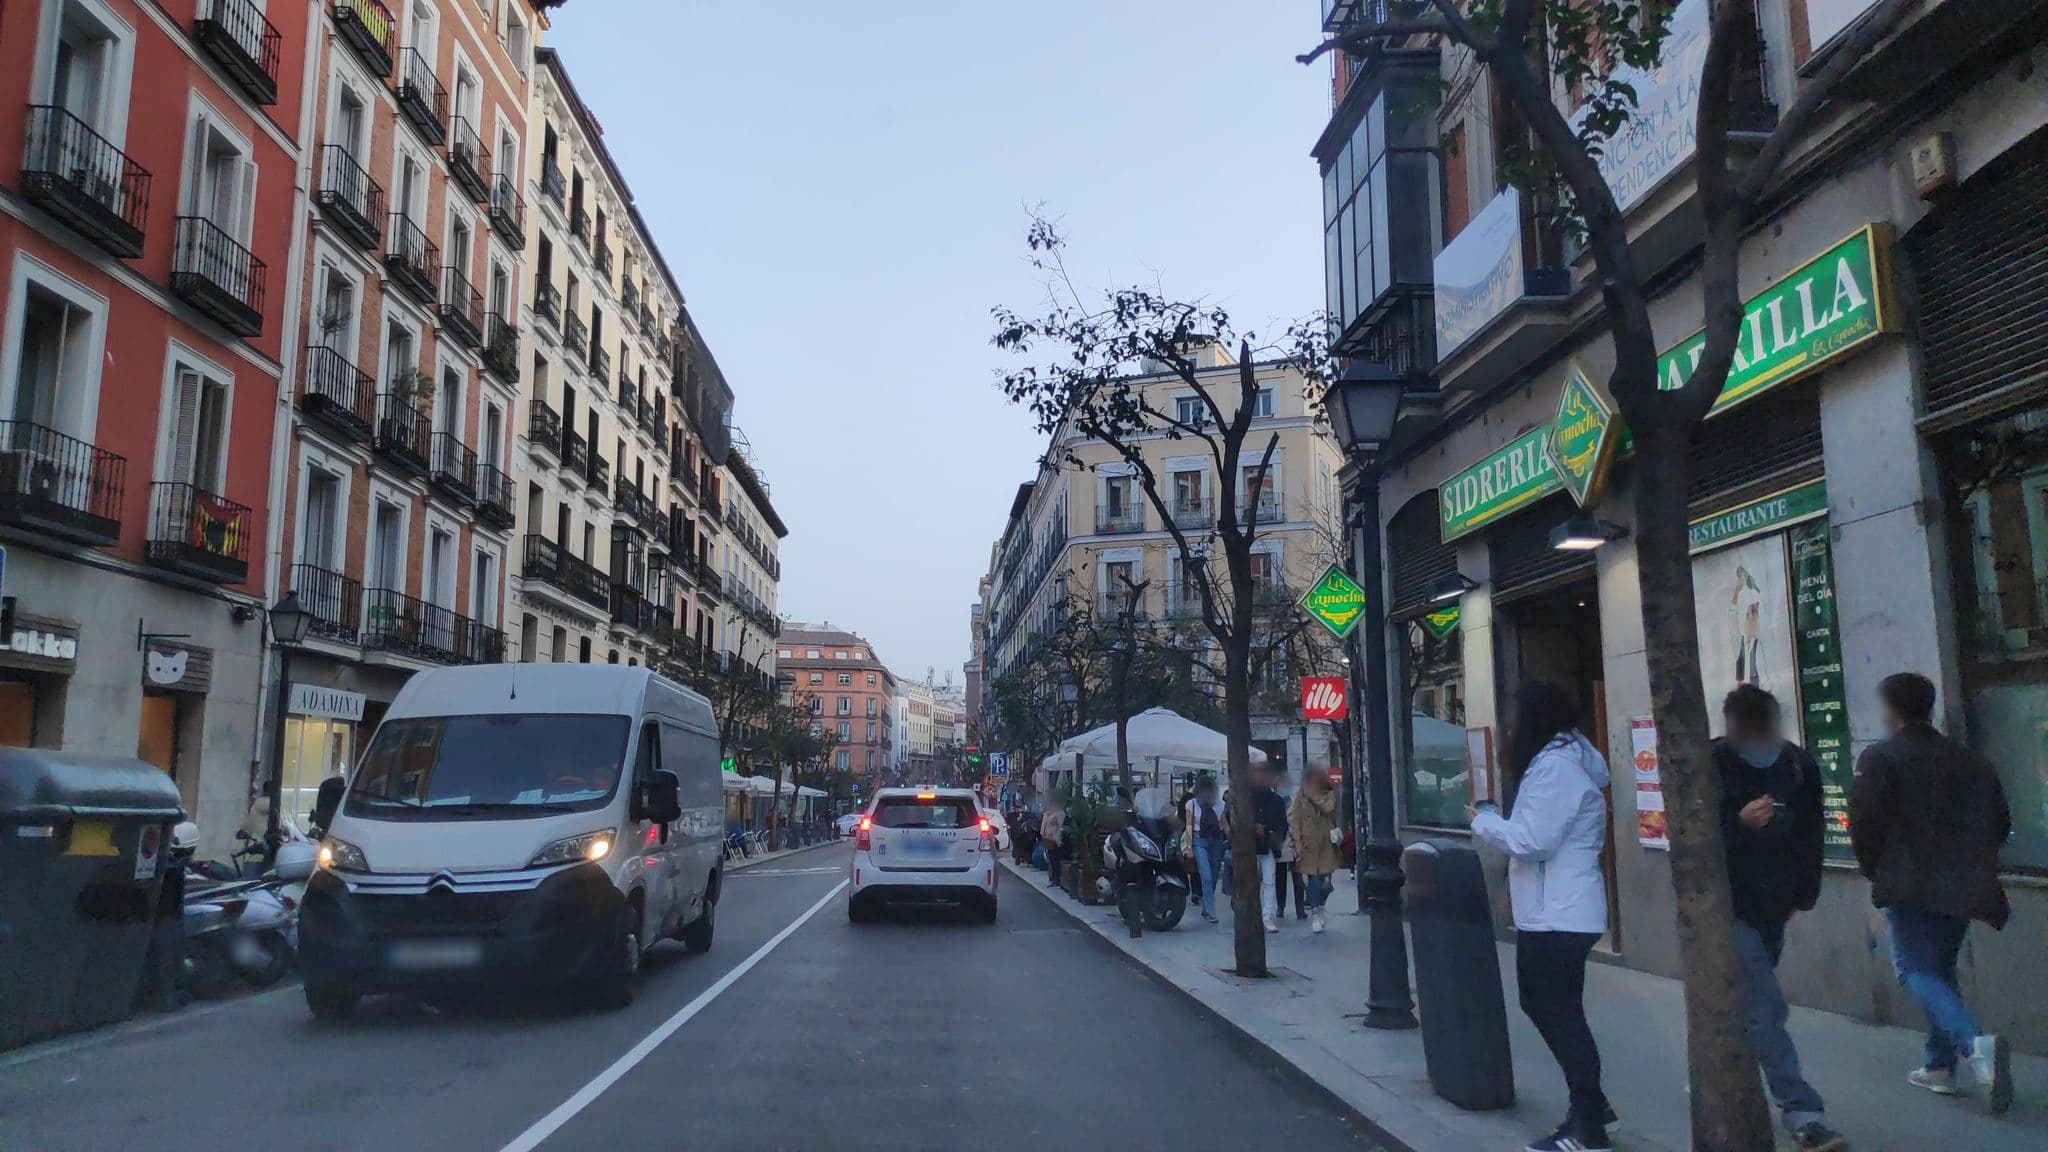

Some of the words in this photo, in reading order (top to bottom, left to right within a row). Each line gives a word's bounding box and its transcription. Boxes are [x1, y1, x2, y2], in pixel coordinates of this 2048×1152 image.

[1444, 433, 1555, 523] SIDRERIA
[1327, 574, 1351, 591] La
[1305, 683, 1343, 716] illy
